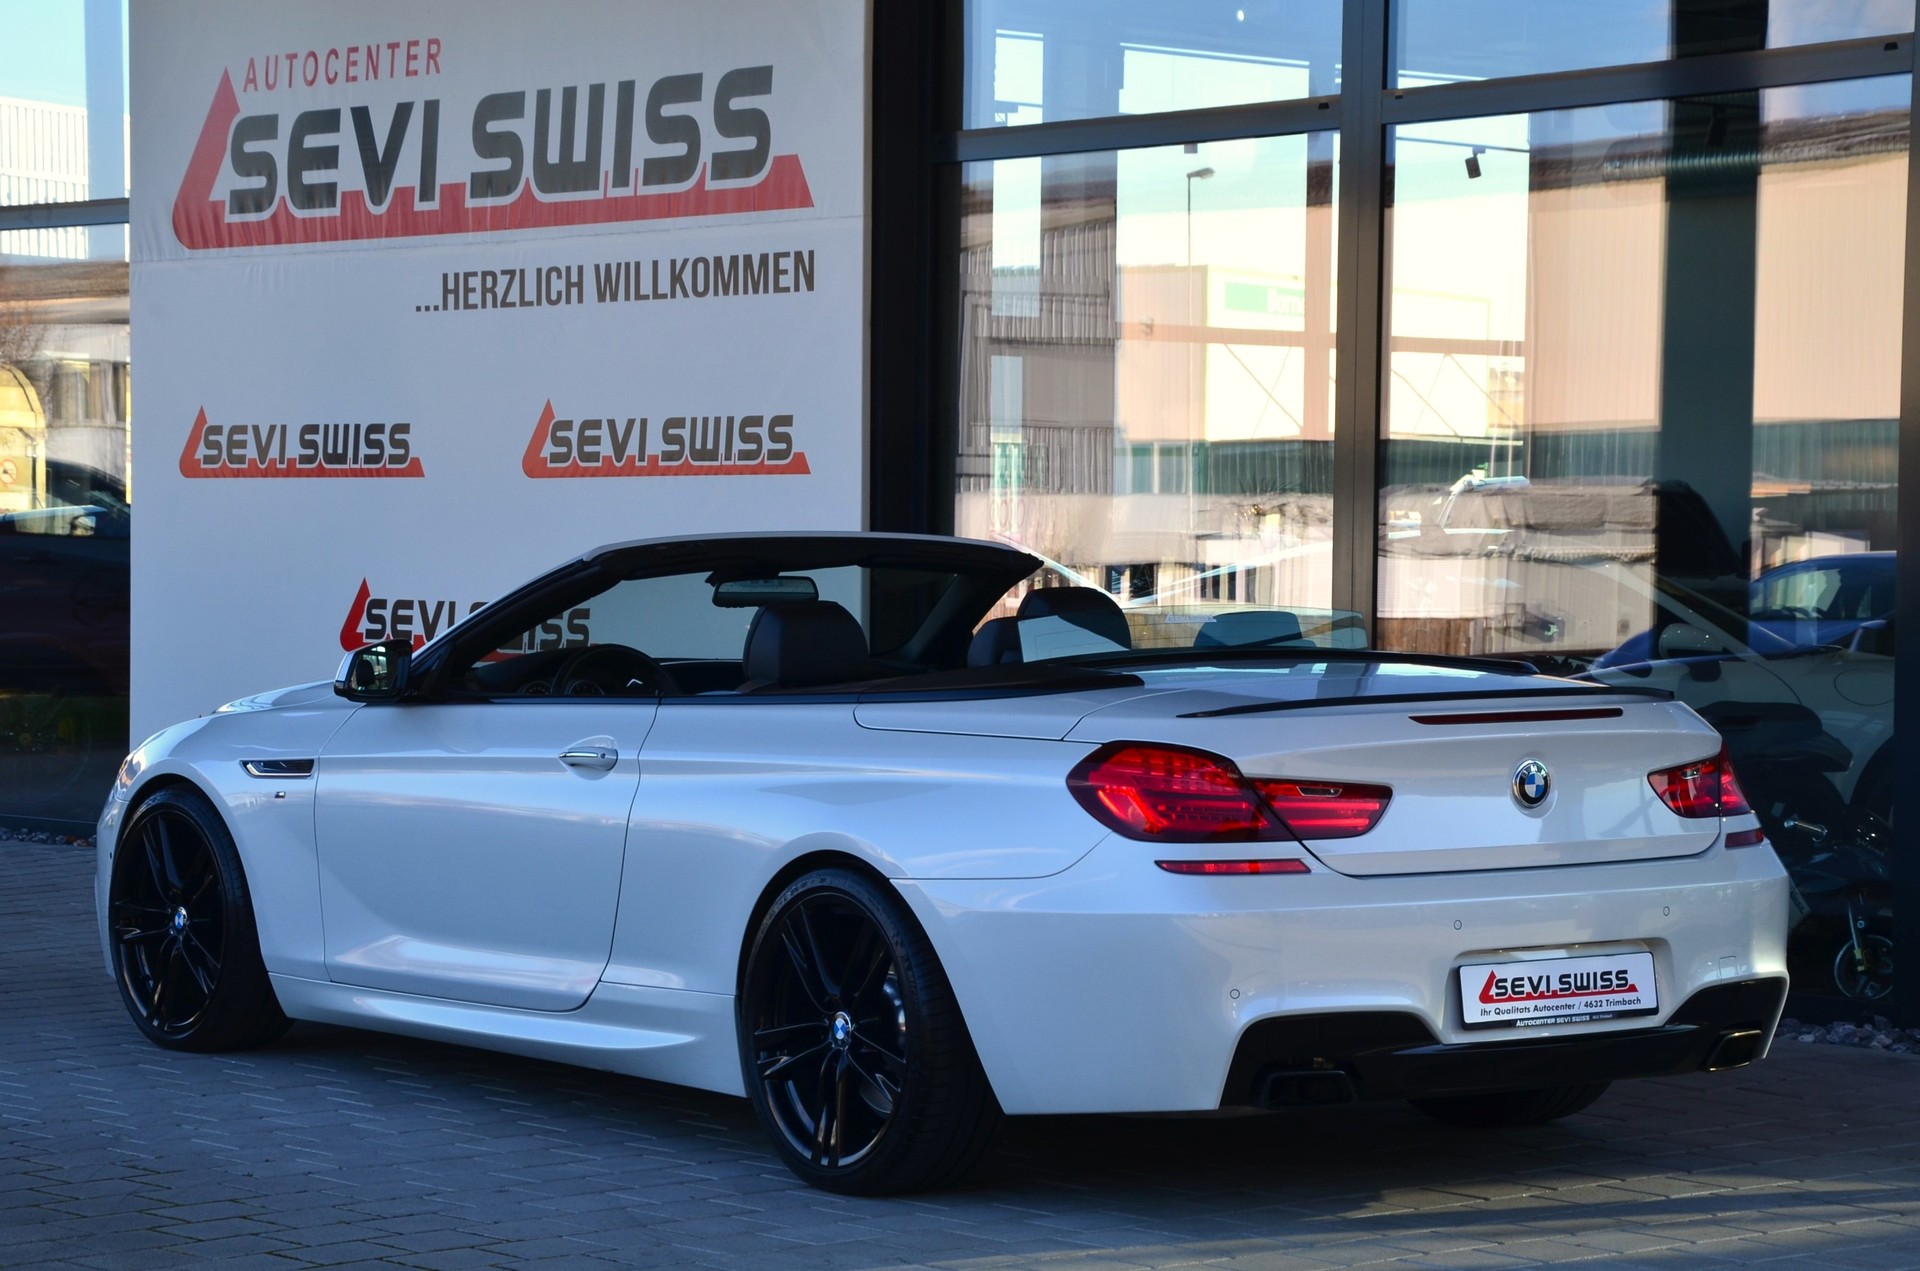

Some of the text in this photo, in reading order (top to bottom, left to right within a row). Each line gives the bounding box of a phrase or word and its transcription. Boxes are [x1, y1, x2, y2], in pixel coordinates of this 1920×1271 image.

[242, 37, 442, 93] AUTOCENTER
[229, 64, 774, 216] SEVI SWISS
[594, 250, 815, 304] WILLKOMMEN
[202, 423, 411, 467] SEVI SWISS
[549, 414, 794, 464] SEVI SWISS
[1480, 1008, 1492, 1017] Ihr
[1532, 1002, 1576, 1013] Autocenter
[1583, 999, 1604, 1009] 4632
[1605, 996, 1642, 1007] Trimbach
[1494, 969, 1629, 998] SEVI SWISS
